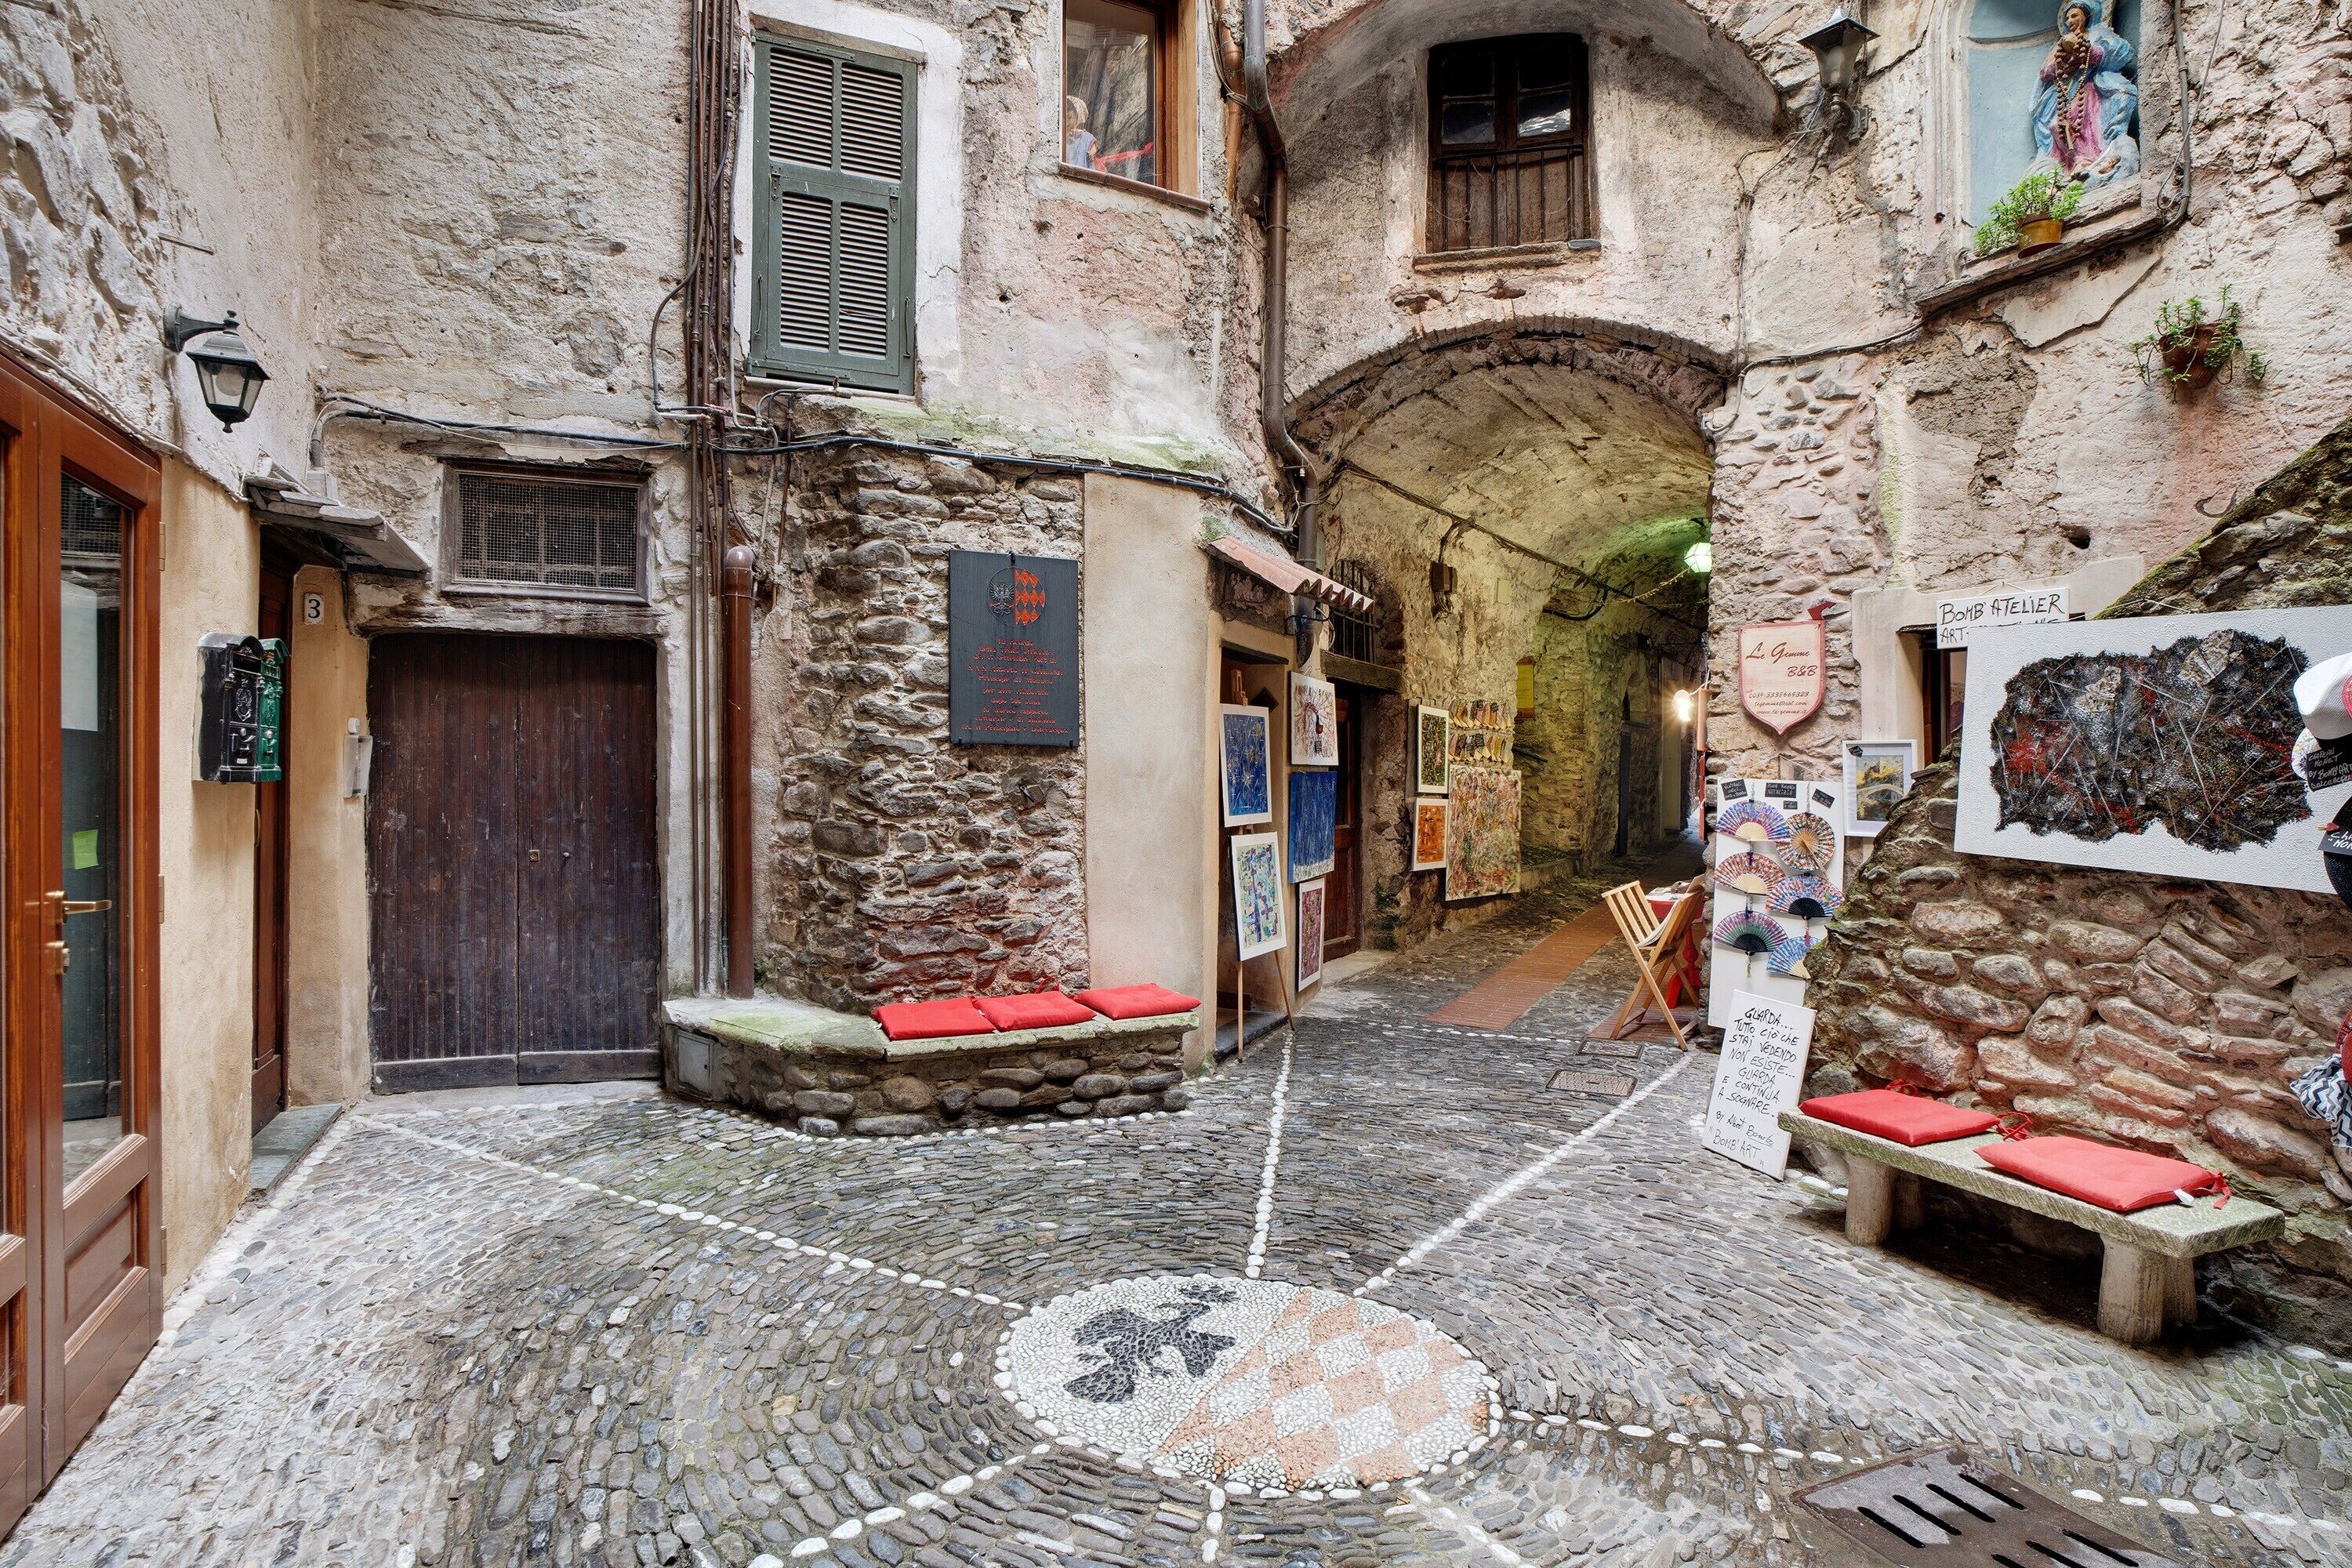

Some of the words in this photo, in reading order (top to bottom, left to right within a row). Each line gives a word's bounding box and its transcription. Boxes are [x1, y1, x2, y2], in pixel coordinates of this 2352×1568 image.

[308, 598, 321, 619] 3
[1745, 642, 1765, 659] Le
[1770, 641, 1810, 664] Gemme
[1787, 665, 1818, 677] B&B
[2308, 770, 2318, 779] BY
[1734, 1018, 1755, 1034] TUTTO
[1727, 1047, 1751, 1063] NON
[1759, 1041, 1797, 1063] VEDENDO
[1738, 1067, 1776, 1085] GUARDA
[1717, 1087, 1725, 1100] A
[1735, 1081, 1780, 1104] CONTINUA
